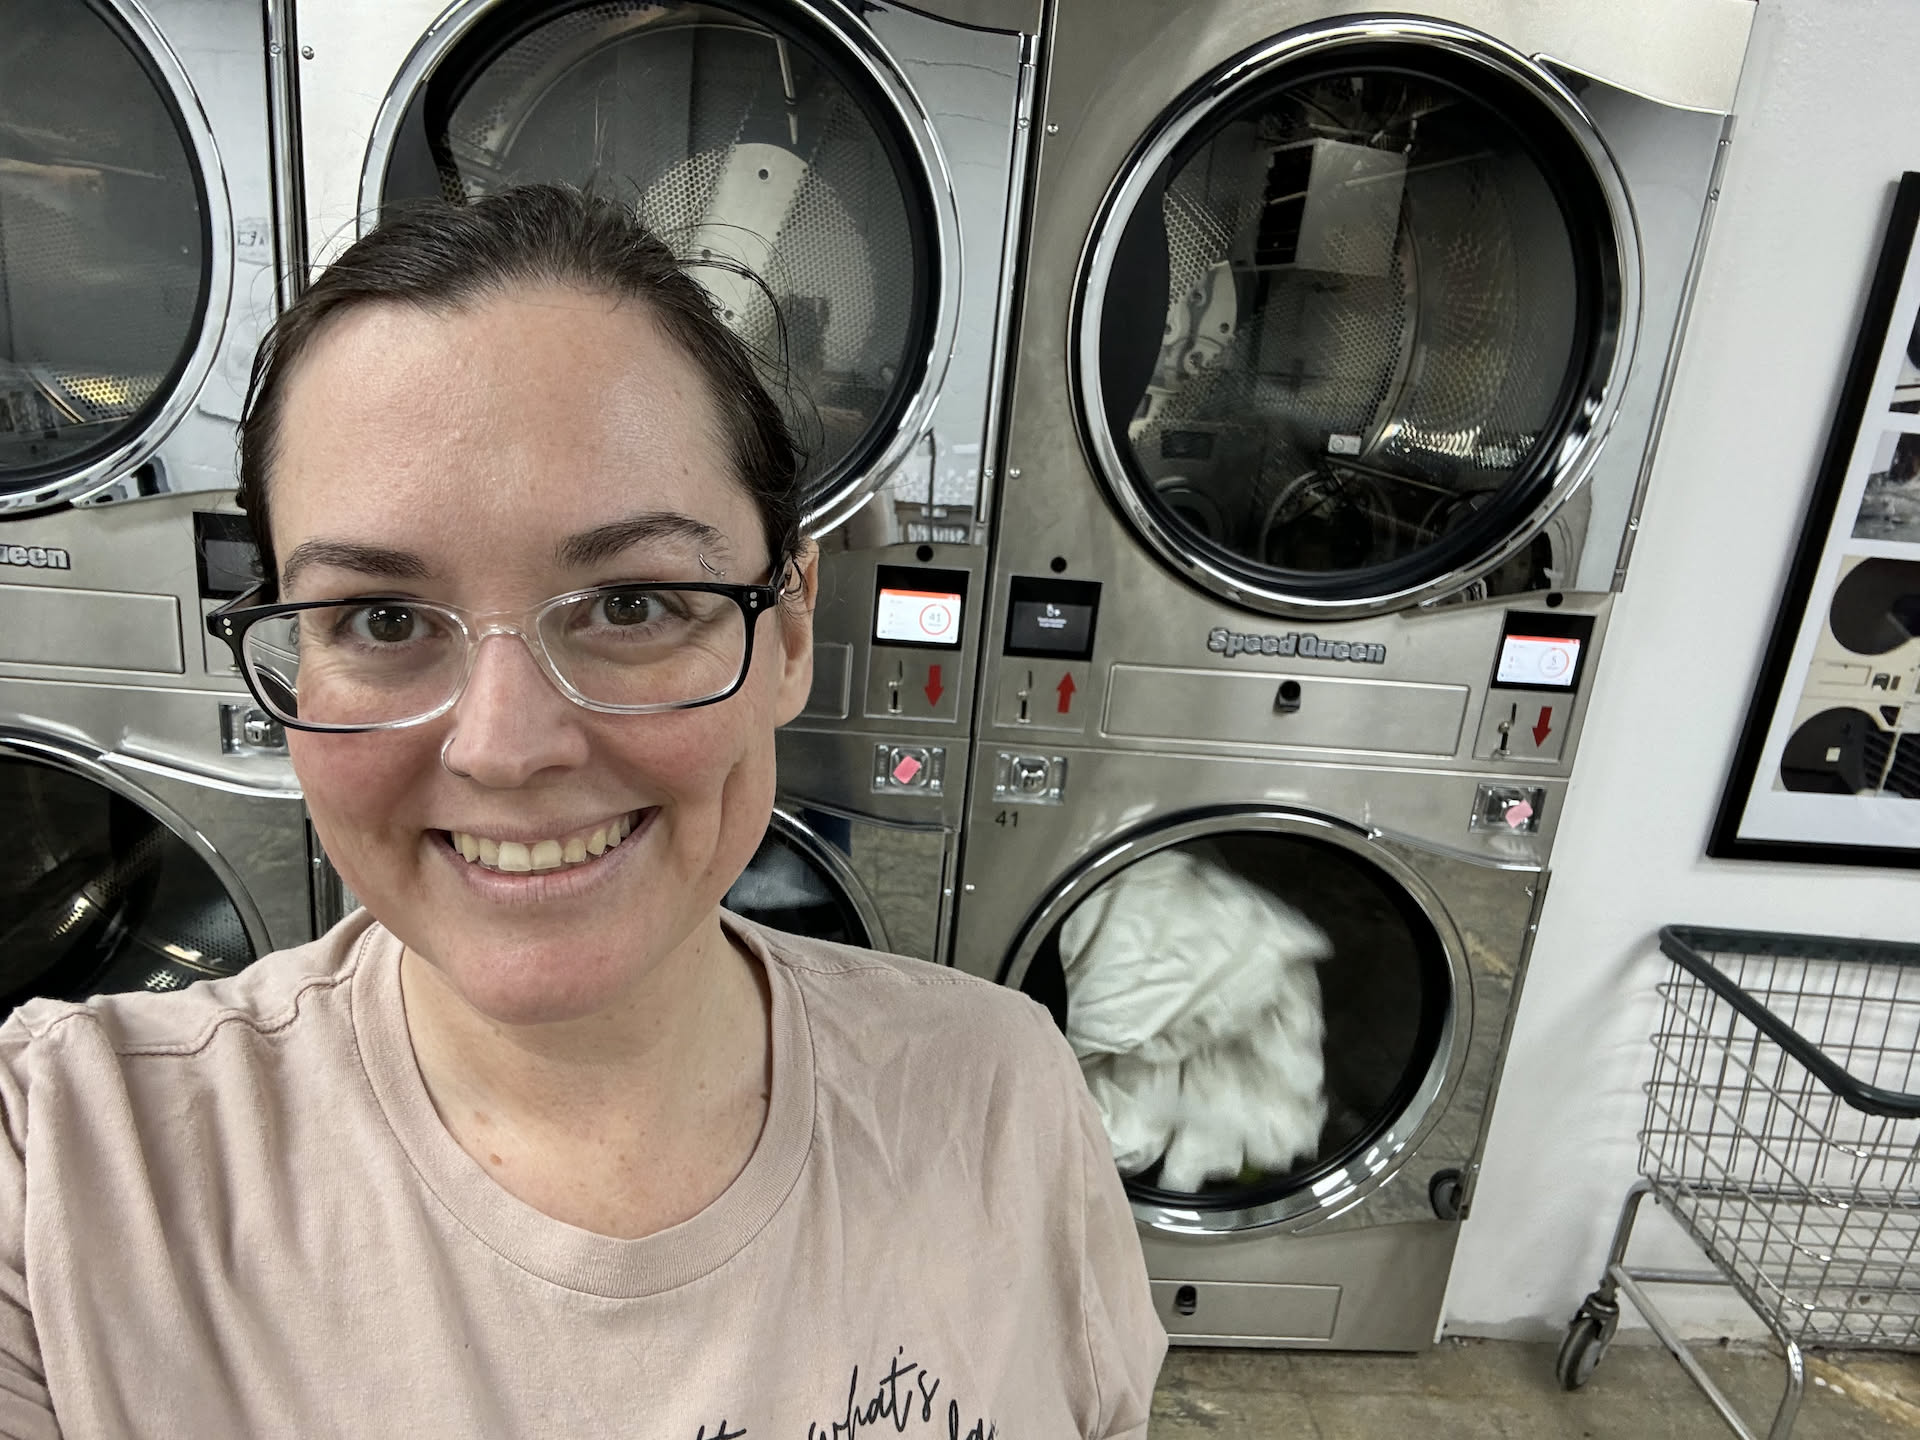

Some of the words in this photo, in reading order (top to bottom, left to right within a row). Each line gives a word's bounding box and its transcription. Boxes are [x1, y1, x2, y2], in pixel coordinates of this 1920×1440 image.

[1207, 627, 1300, 658] Speed
[1298, 633, 1386, 664] Queen
[995, 810, 1018, 828] 41
[808, 1346, 940, 1440] what's
